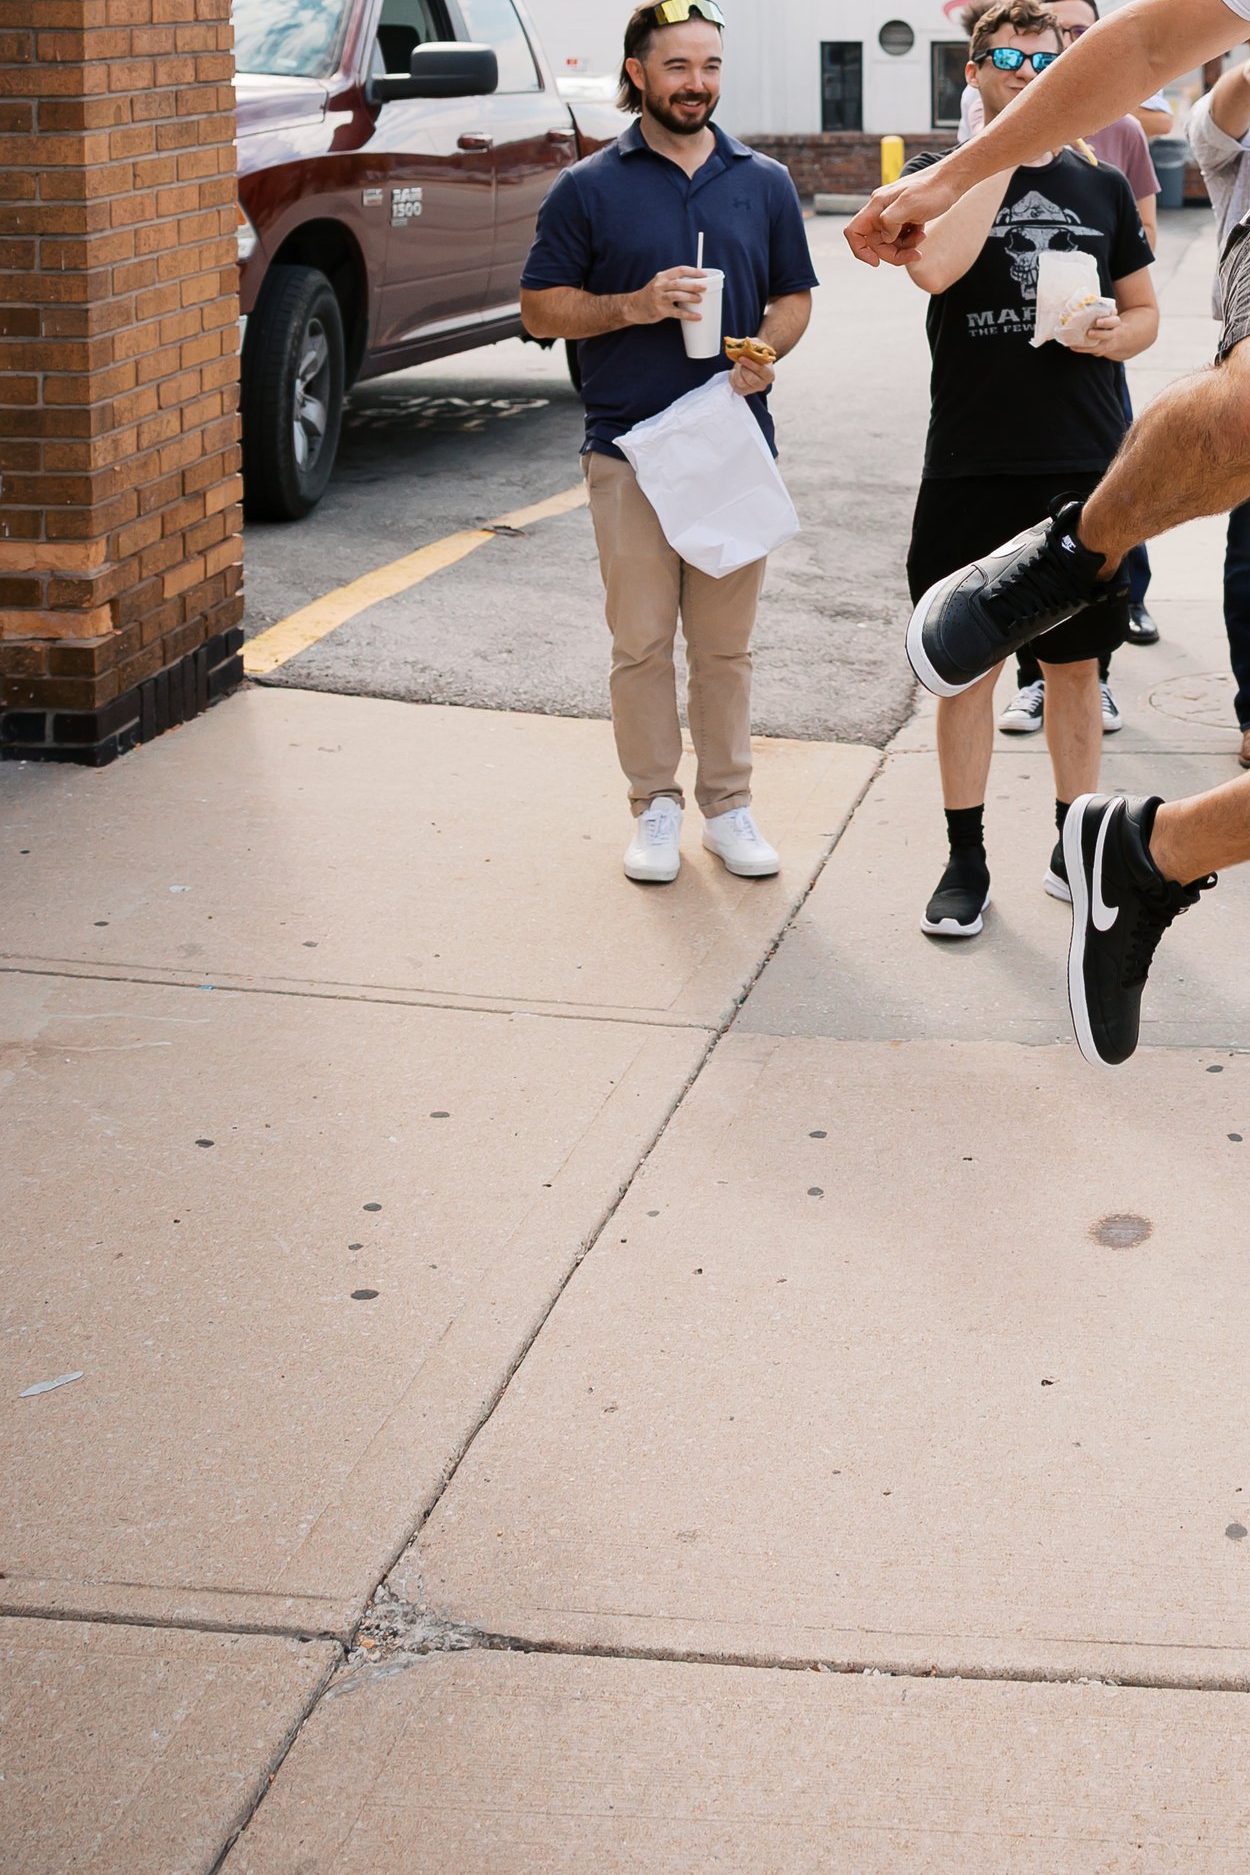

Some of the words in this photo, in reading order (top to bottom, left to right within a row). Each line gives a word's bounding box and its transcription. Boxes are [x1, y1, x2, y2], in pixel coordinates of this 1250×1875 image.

[392, 187, 422, 202] RAM
[392, 202, 422, 217] 1500
[968, 327, 998, 337] THE
